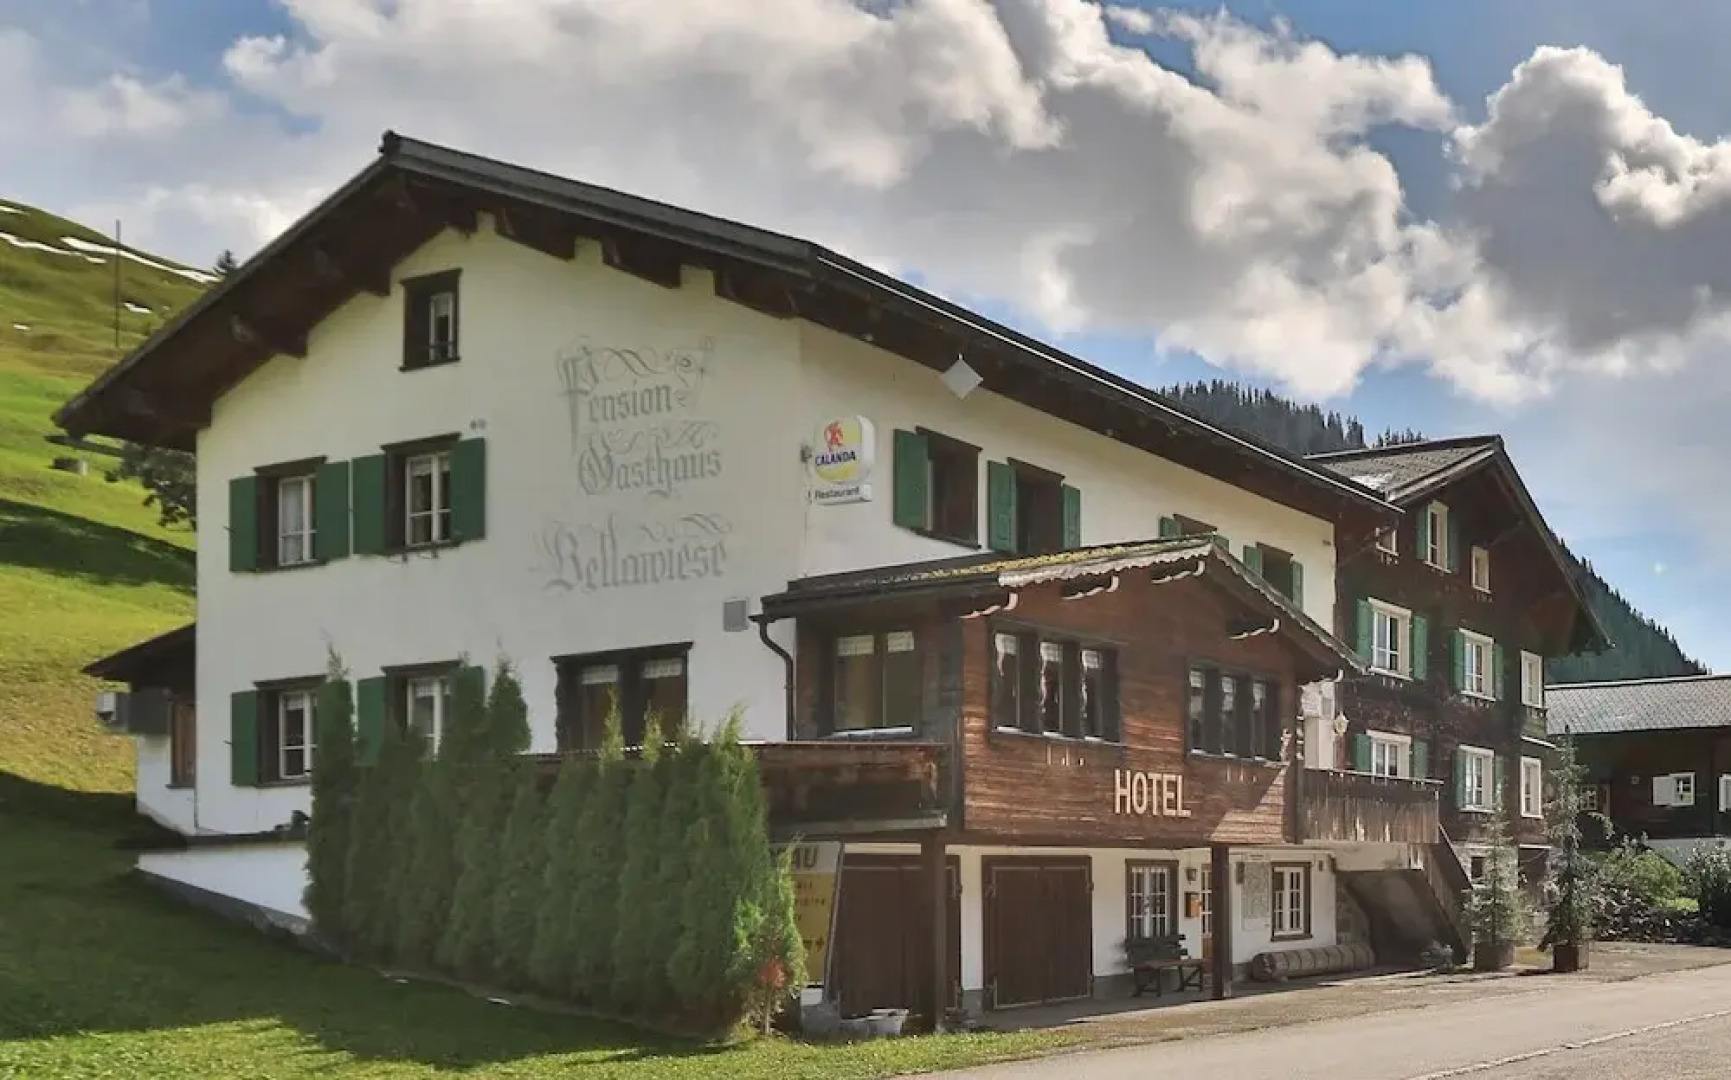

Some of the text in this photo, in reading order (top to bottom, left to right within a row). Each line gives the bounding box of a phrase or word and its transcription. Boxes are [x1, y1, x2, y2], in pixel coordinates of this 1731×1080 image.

[577, 431, 723, 499] Gasthaus
[815, 450, 856, 466] CALANDA
[814, 486, 860, 499] Restaurant
[1114, 768, 1192, 817] HOTEL
